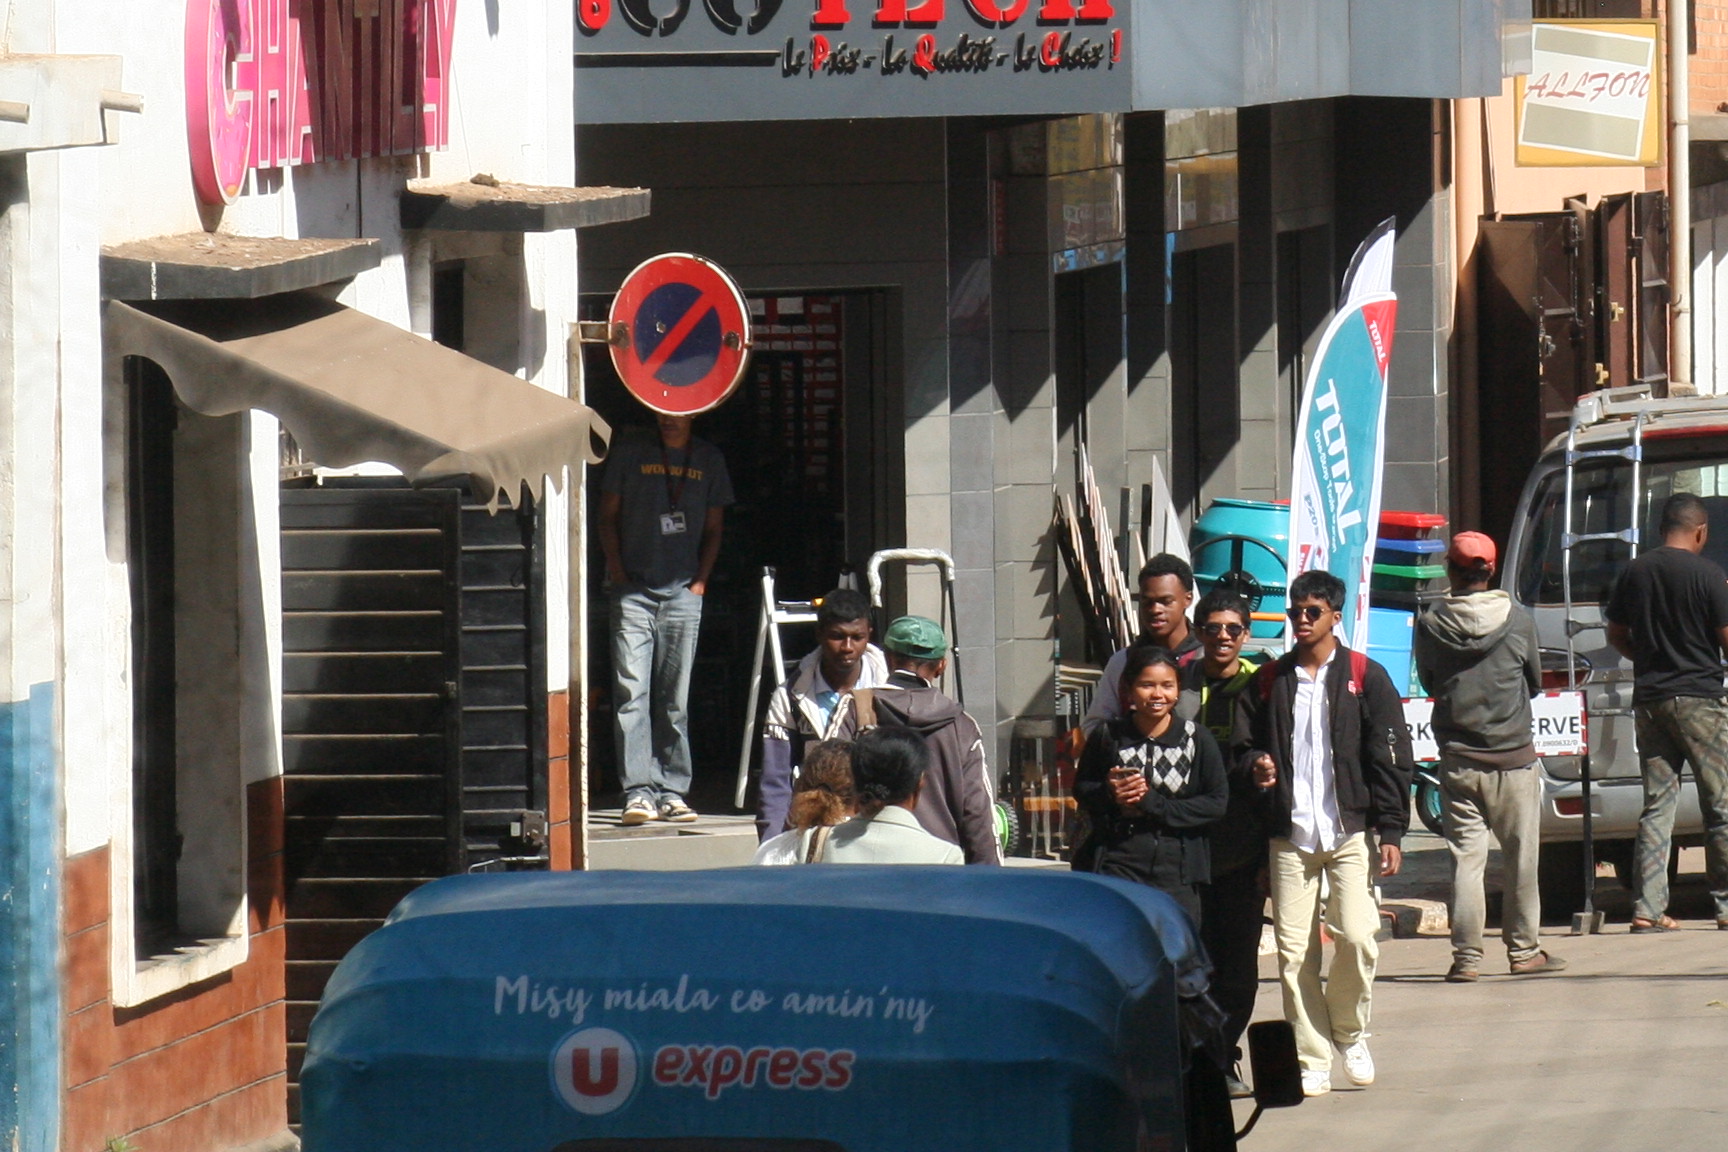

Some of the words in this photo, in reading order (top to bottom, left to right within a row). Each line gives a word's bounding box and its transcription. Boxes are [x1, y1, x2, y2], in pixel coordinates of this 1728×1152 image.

[810, 32, 860, 77] Prix
[1369, 320, 1387, 362] TOTAL
[1315, 378, 1362, 545] TOTAL
[494, 975, 593, 1024] Misy
[604, 974, 718, 1012] miala
[782, 984, 935, 1034] amin'ny
[572, 1047, 619, 1097] U
[654, 1045, 854, 1099] express
